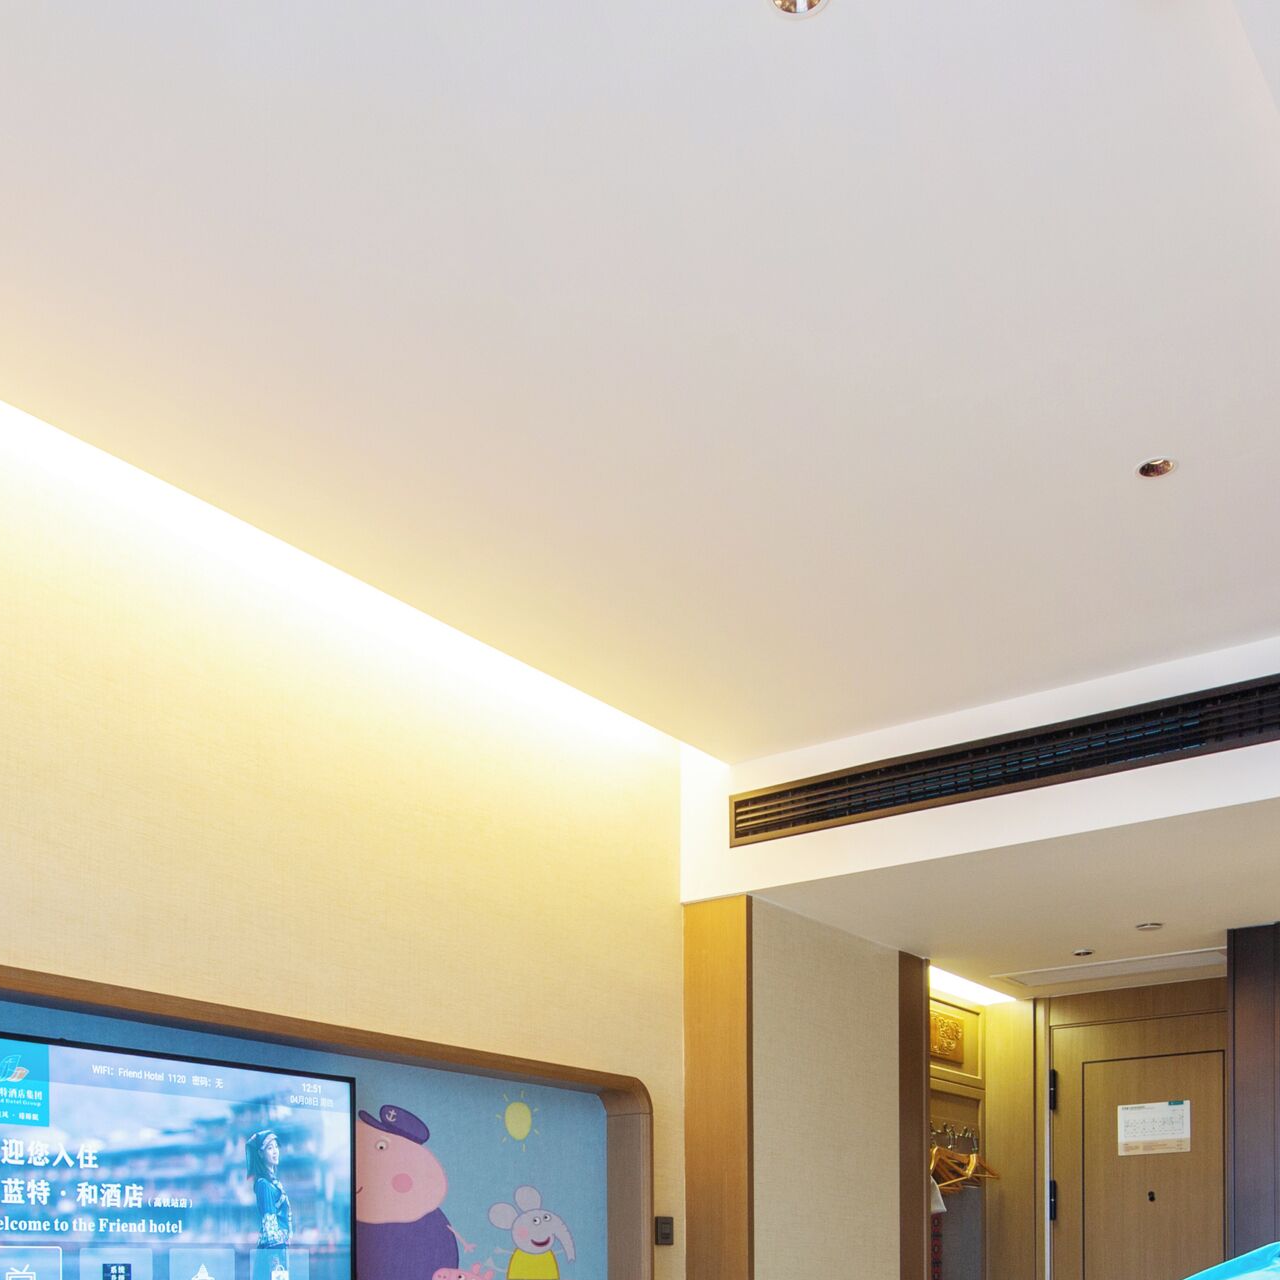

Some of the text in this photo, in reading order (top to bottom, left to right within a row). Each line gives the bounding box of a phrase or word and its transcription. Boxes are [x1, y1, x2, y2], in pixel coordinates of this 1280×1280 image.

[119, 1068, 142, 1079] Friend
[144, 1070, 164, 1082] Hotel
[168, 1074, 186, 1084] 1120
[53, 1217, 69, 1232] to
[72, 1217, 95, 1232] the
[99, 1218, 145, 1233] Friend
[149, 1219, 182, 1234] hotel
